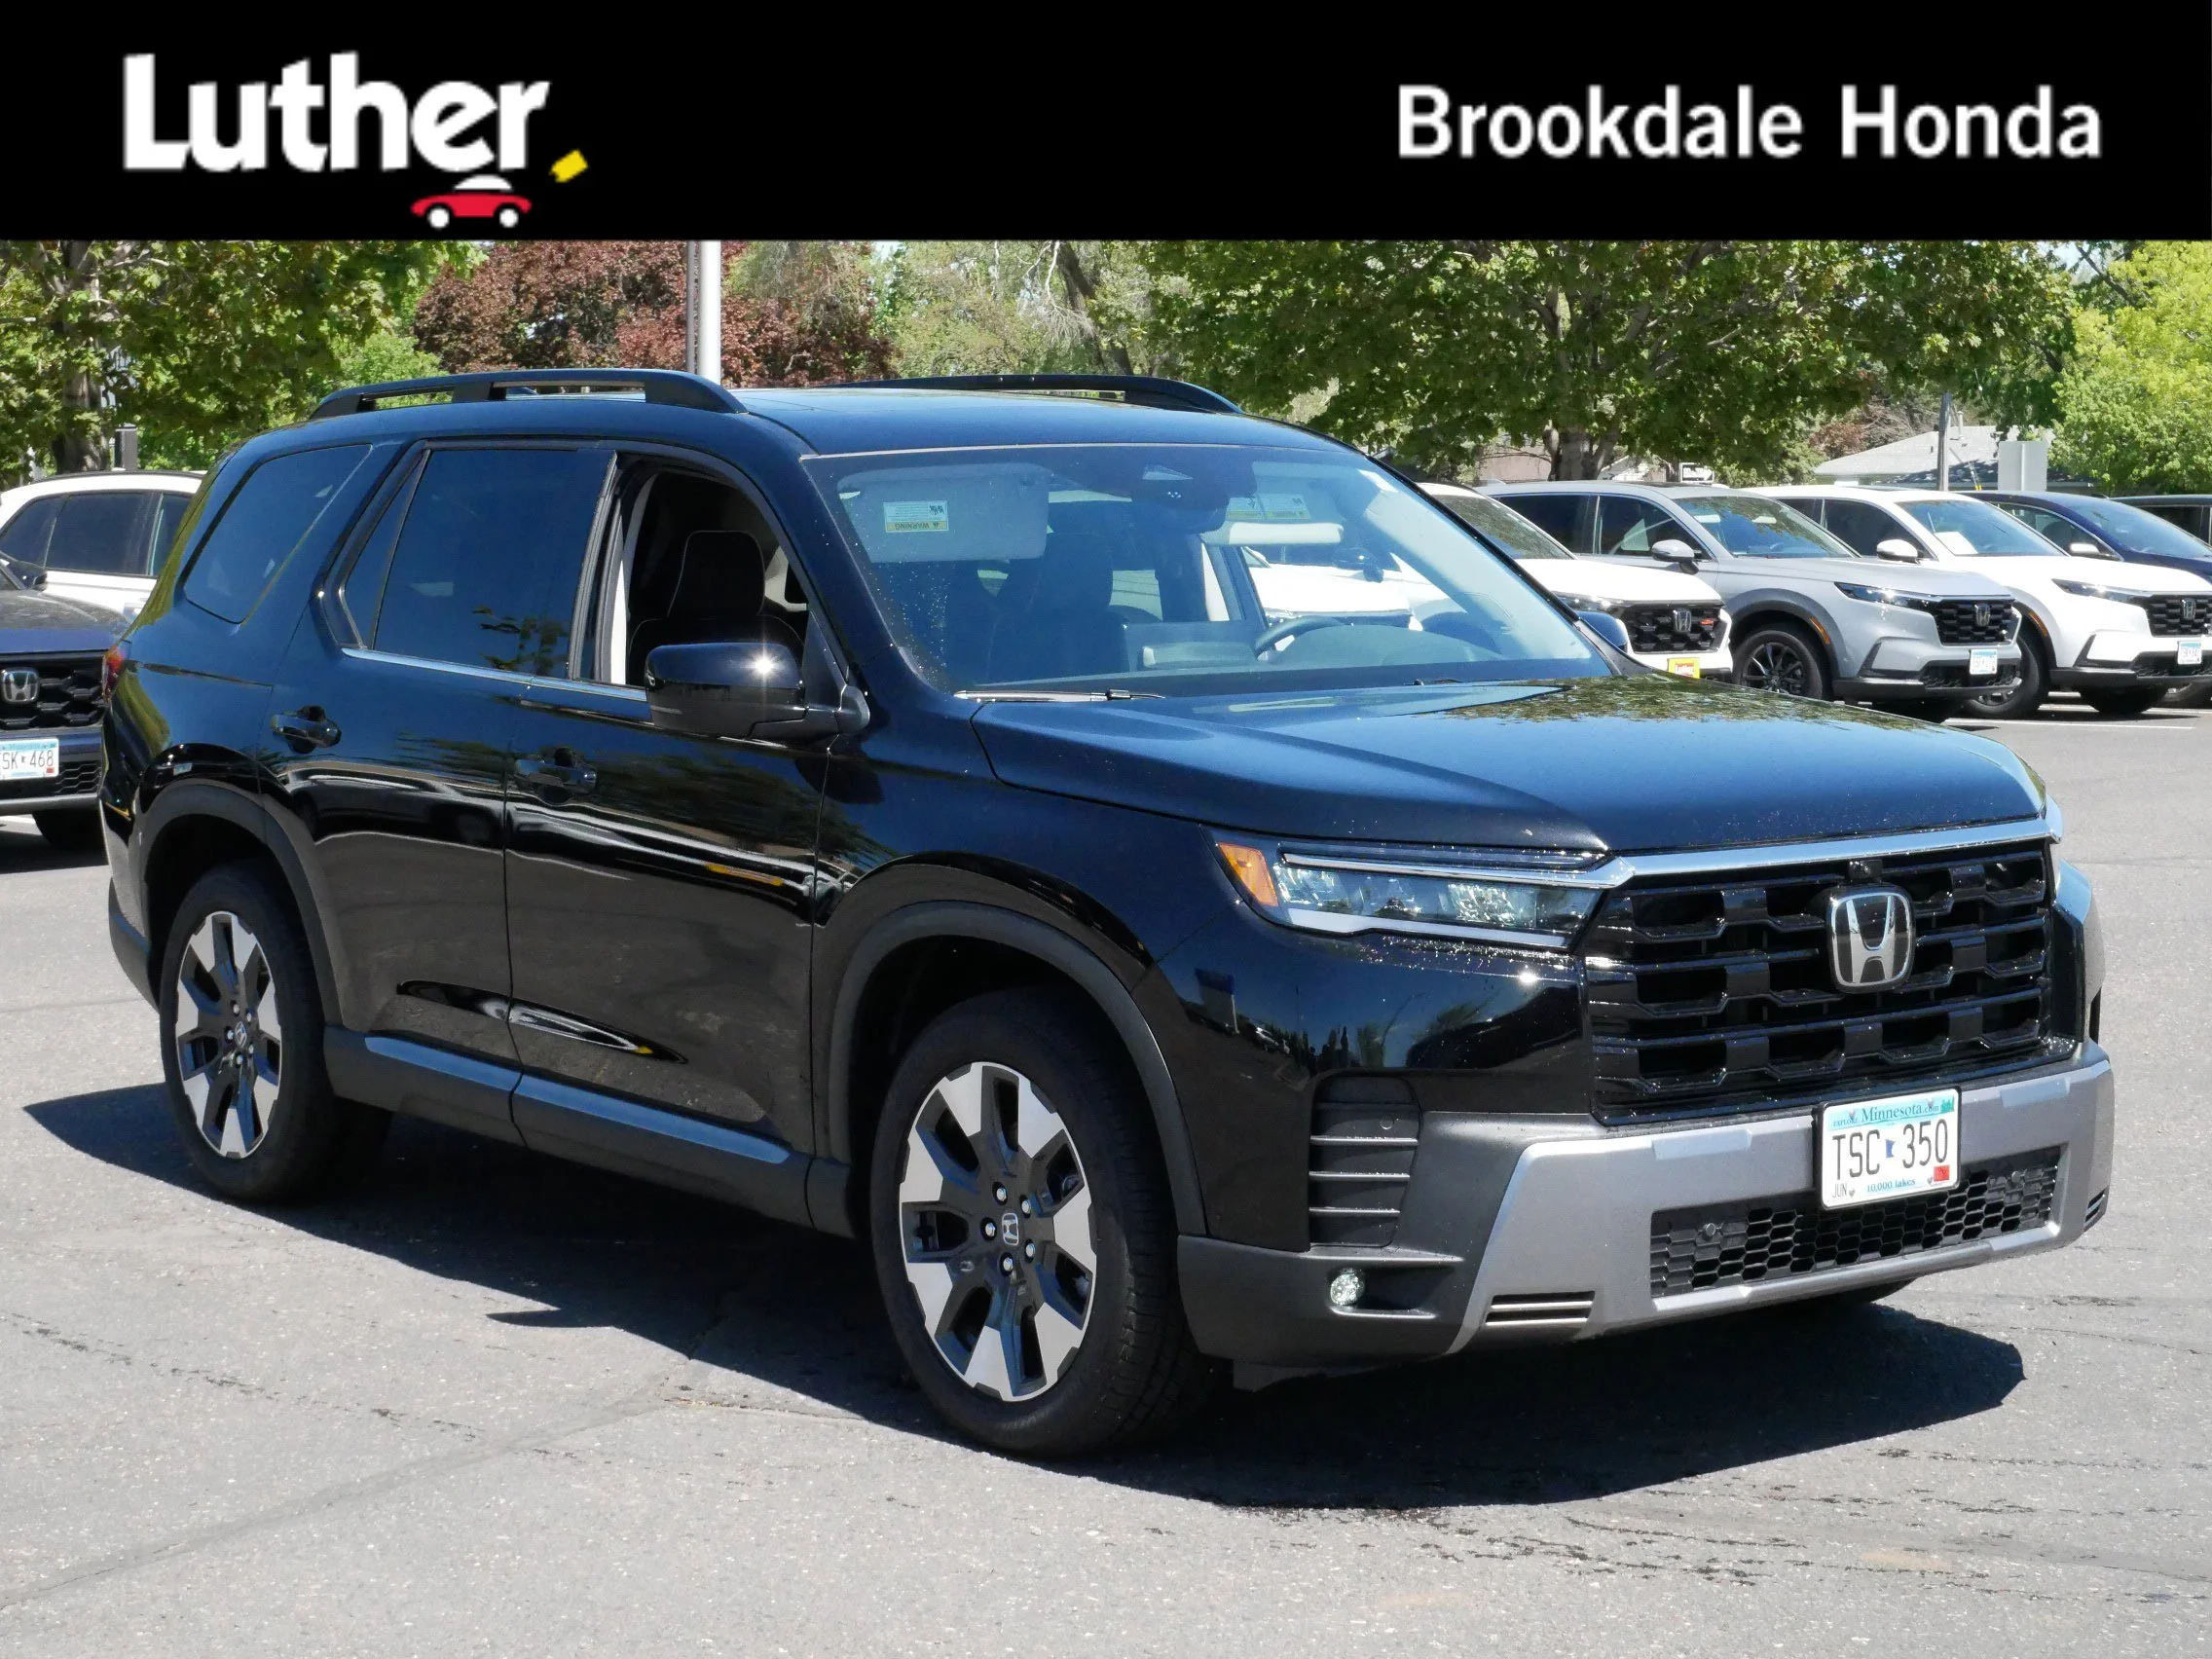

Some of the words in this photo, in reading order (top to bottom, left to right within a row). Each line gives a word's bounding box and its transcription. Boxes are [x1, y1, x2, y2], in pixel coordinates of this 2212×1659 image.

[895, 522, 930, 531] WARNING
[0, 752, 18, 770] SK
[29, 750, 55, 767] 468
[1832, 1129, 1880, 1180] TSC
[1902, 1119, 1948, 1168] 350
[1832, 1183, 1848, 1198] JUN
[1866, 1182, 1893, 1193] 10,000
[1895, 1178, 1916, 1189] lakes
